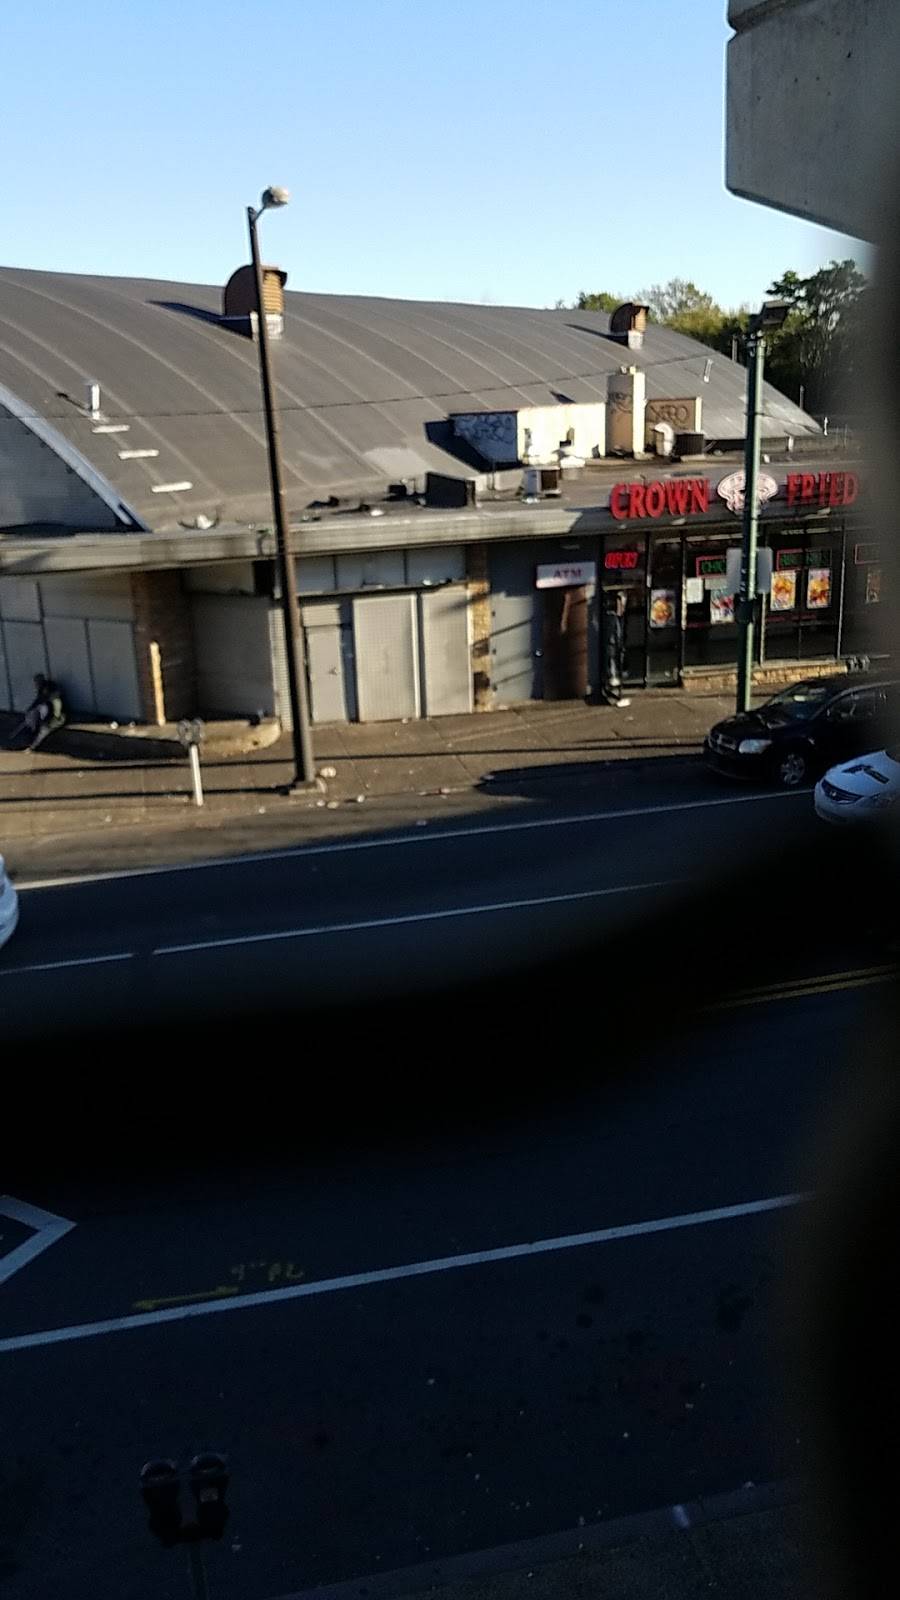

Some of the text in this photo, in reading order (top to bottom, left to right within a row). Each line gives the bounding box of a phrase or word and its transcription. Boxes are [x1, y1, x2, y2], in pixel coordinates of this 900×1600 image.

[609, 471, 859, 520] CROWN FRIED
[552, 568, 583, 579] ATM
